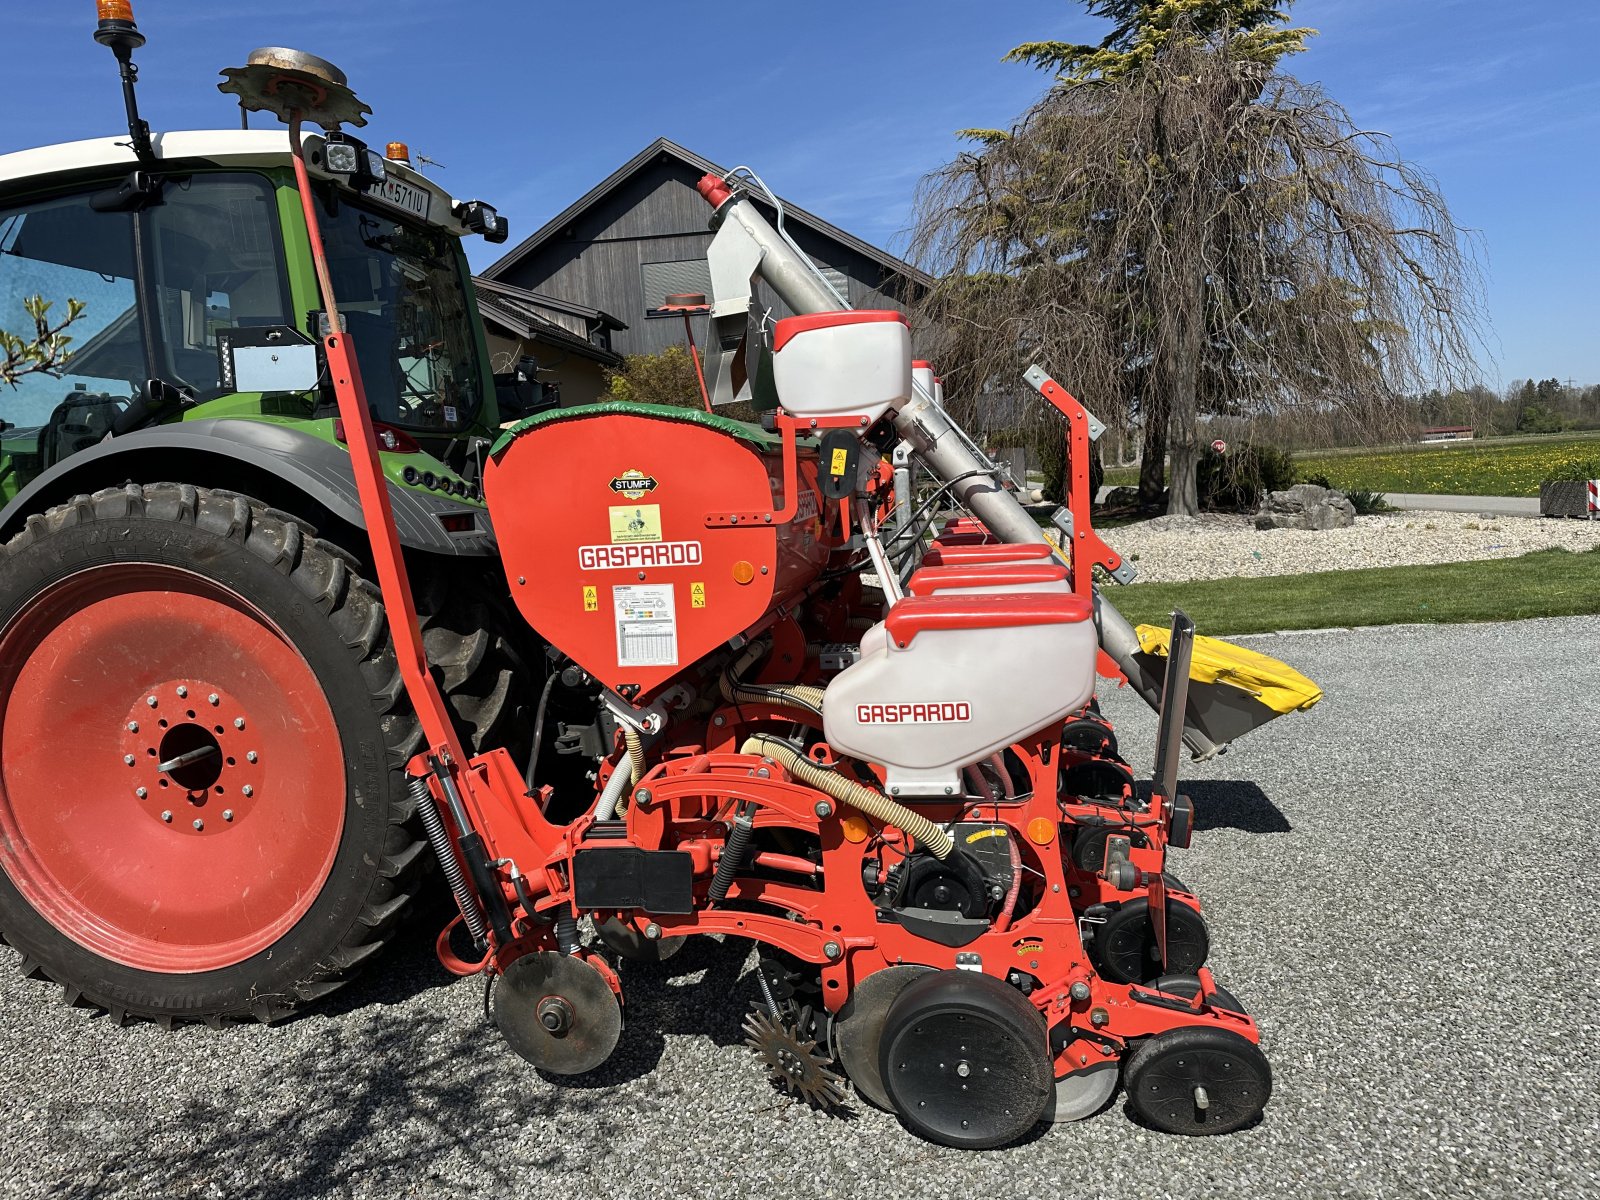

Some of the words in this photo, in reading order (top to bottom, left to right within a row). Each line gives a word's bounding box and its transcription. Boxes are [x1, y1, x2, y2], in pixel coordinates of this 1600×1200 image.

[616, 480, 651, 489] STUMPF
[581, 543, 700, 568] GASPARDO
[857, 703, 970, 722] GASPARDO
